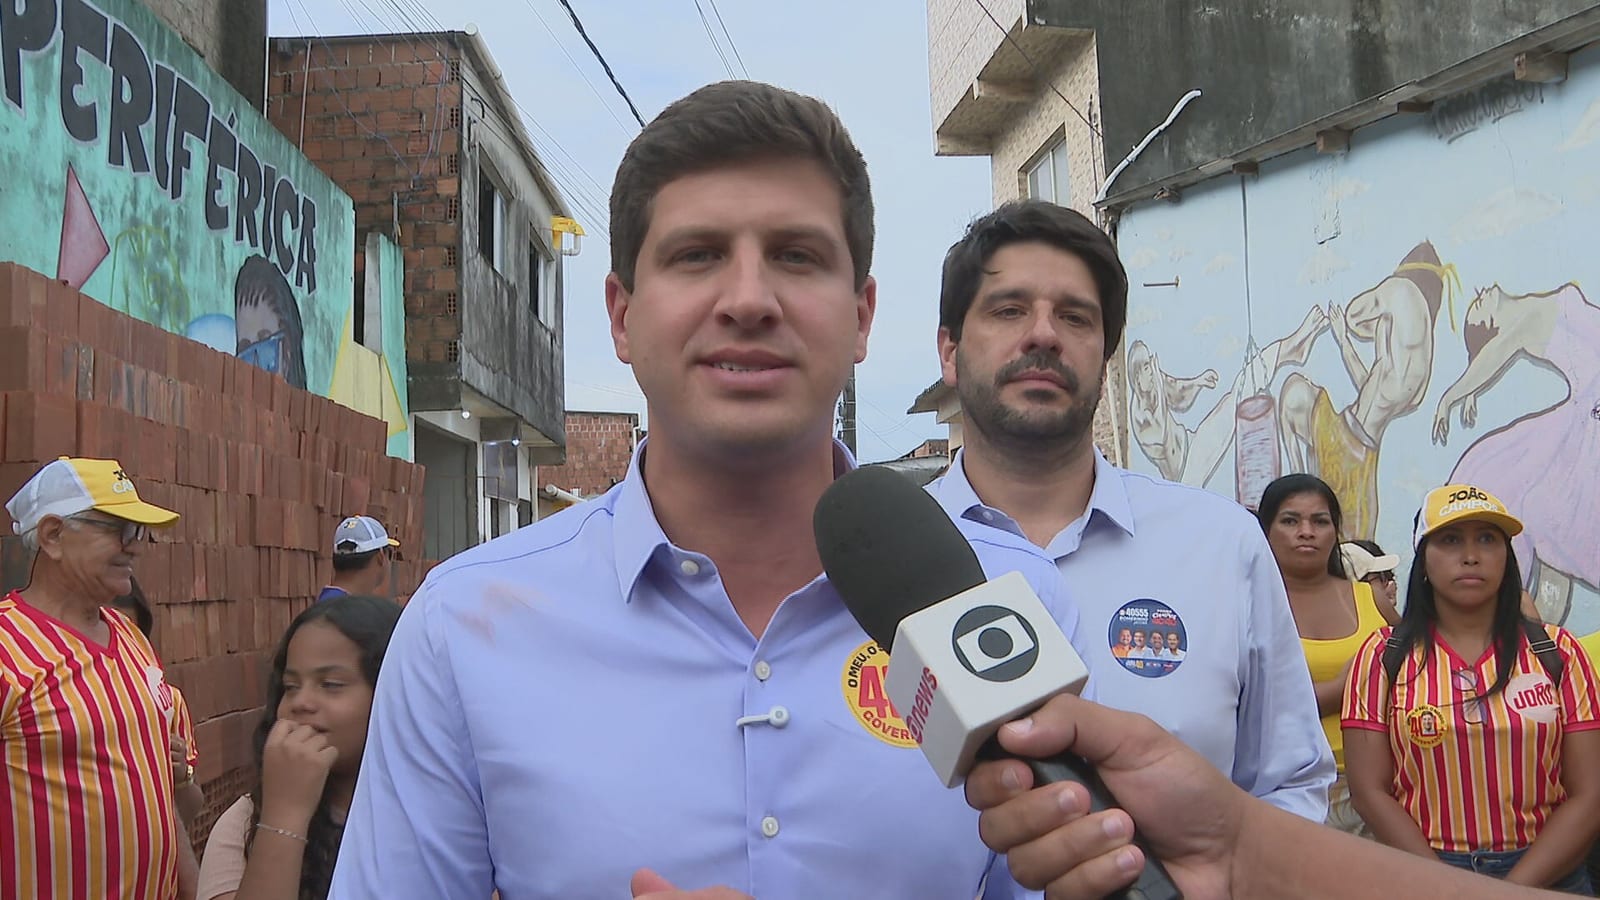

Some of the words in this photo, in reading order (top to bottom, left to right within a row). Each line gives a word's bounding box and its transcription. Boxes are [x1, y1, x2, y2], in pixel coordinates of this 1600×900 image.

[1449, 487, 1488, 504] JOÃO
[1439, 500, 1498, 516] CAMPOS
[847, 679, 858, 688] O
[868, 645, 877, 655] O
